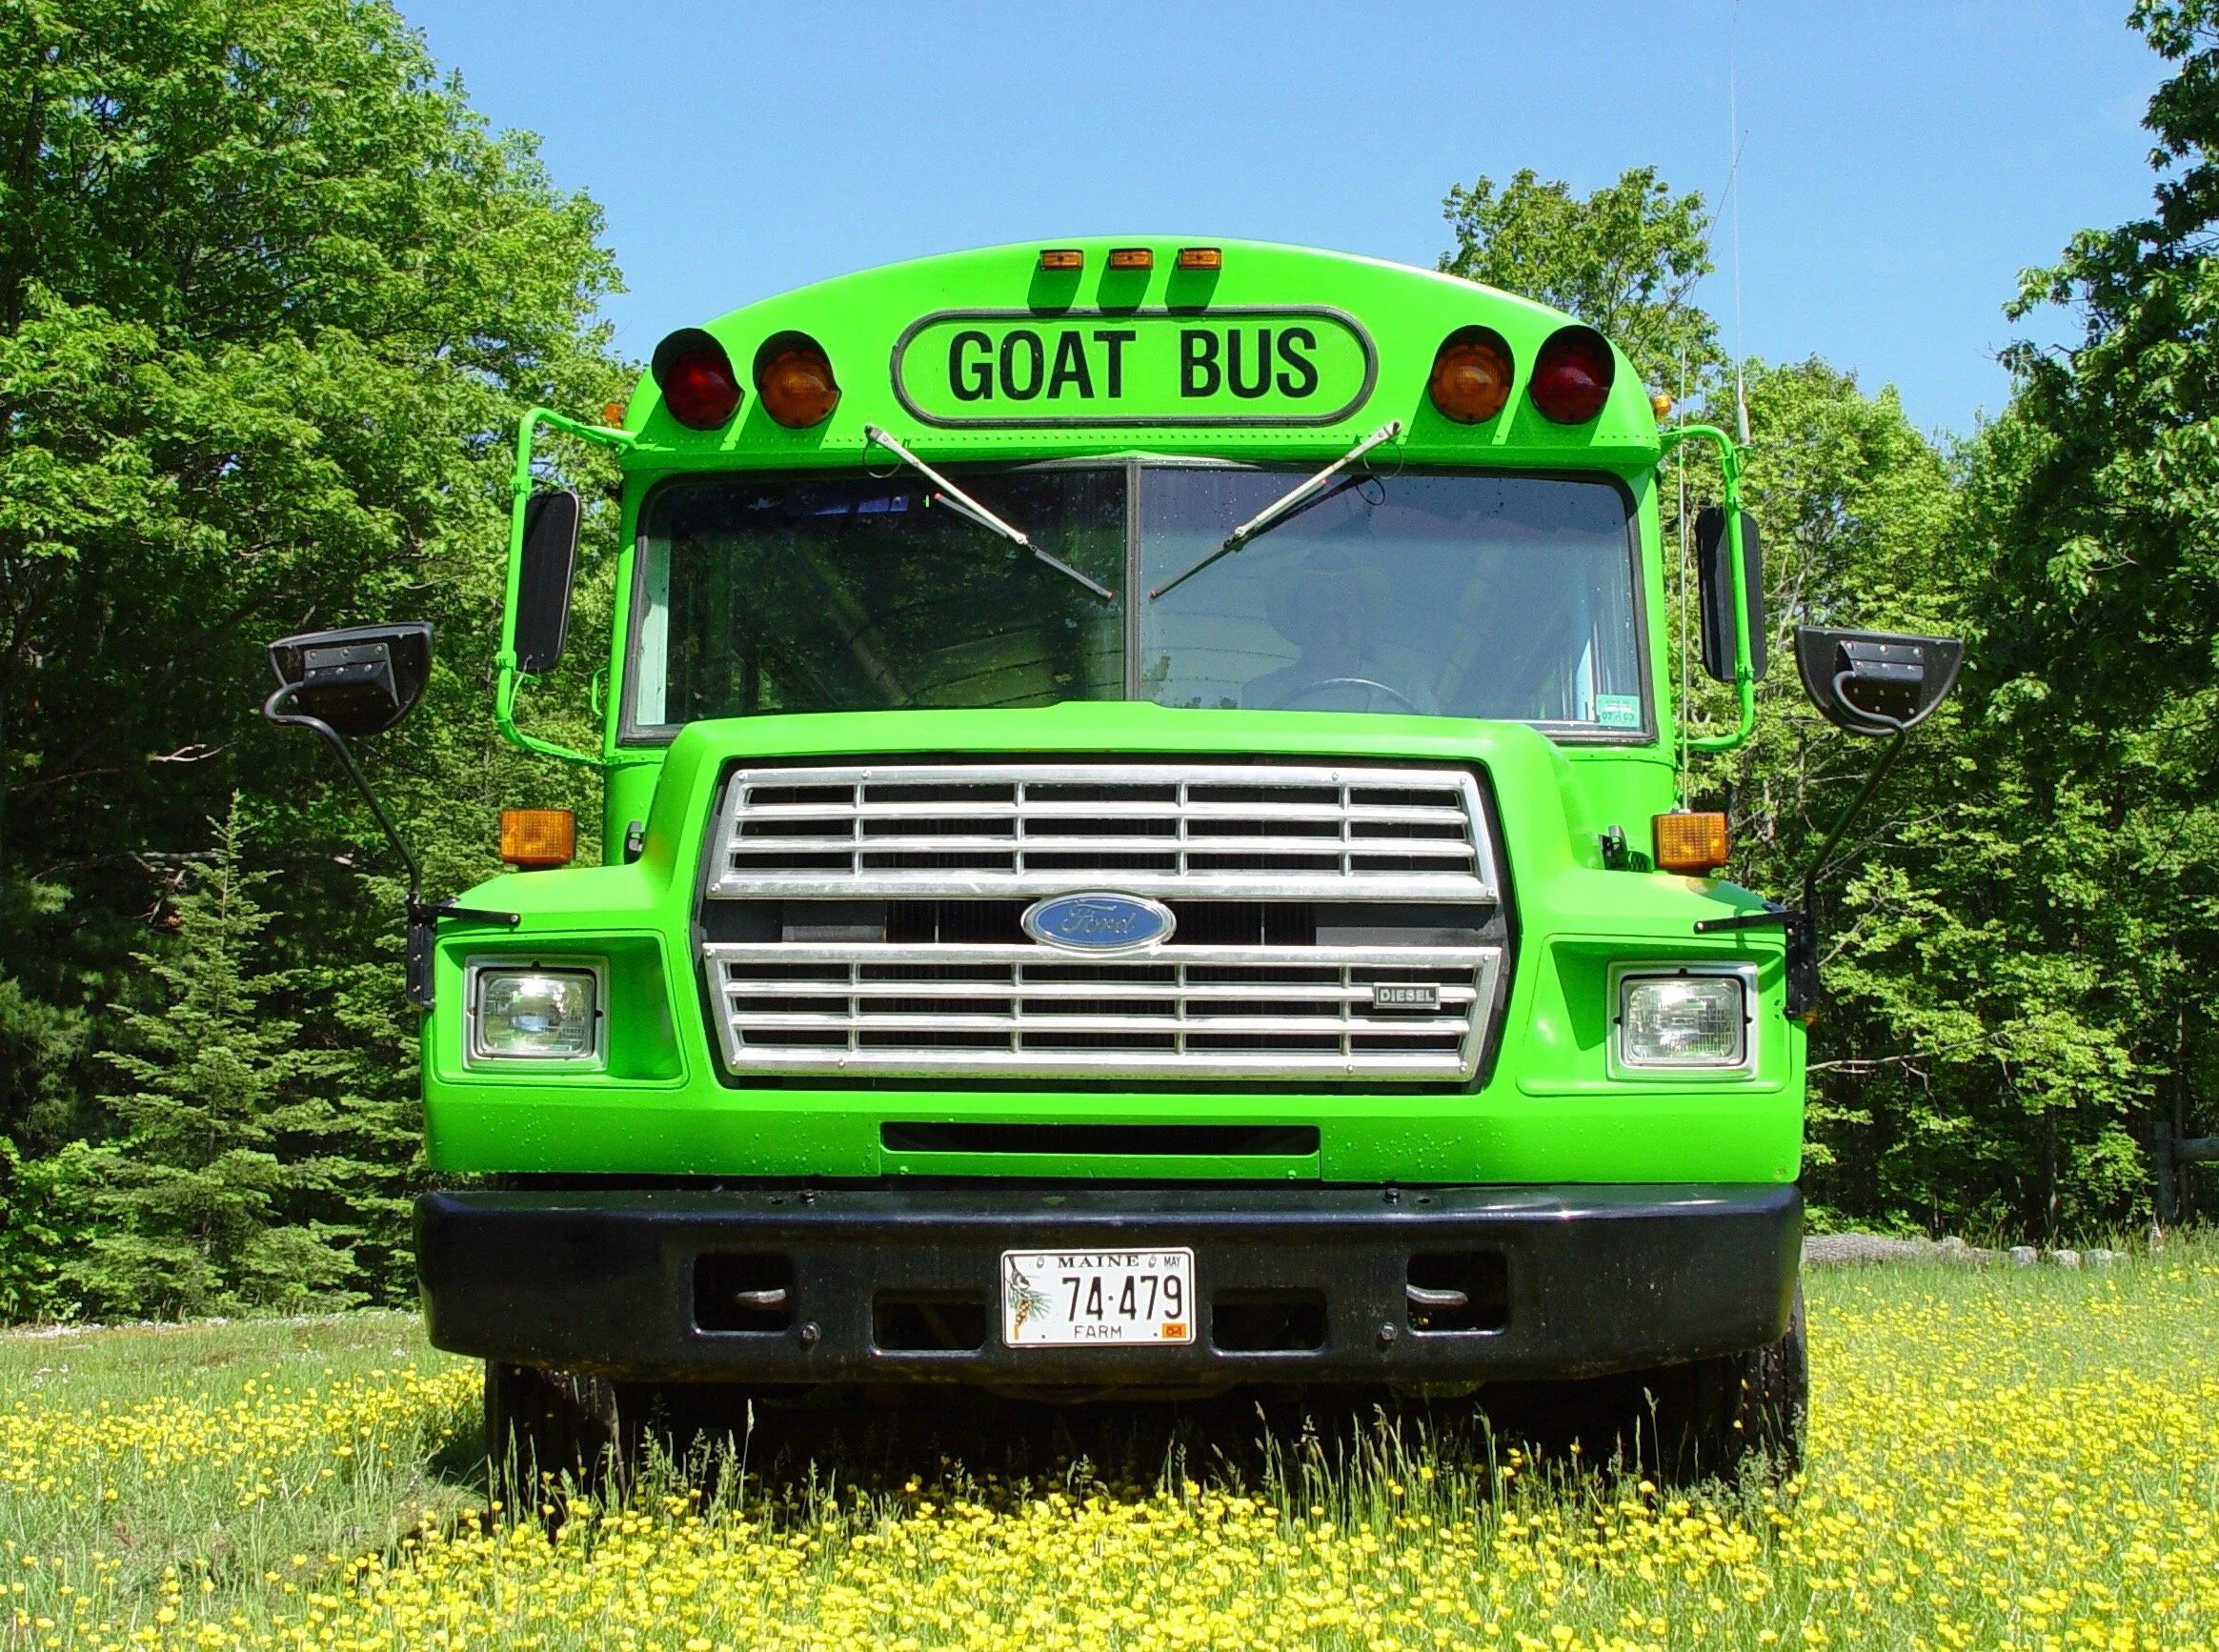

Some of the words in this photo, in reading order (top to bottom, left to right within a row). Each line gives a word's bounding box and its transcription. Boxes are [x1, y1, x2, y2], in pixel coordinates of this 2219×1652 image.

[949, 329, 1136, 401] GOAT
[1180, 327, 1319, 399] BUS
[1060, 903, 1137, 935] Ford
[1380, 988, 1435, 1002] DIESEL
[1057, 1255, 1140, 1269] MAINE
[1163, 1256, 1181, 1267] MAY
[1074, 1325, 1122, 1339] FARM
